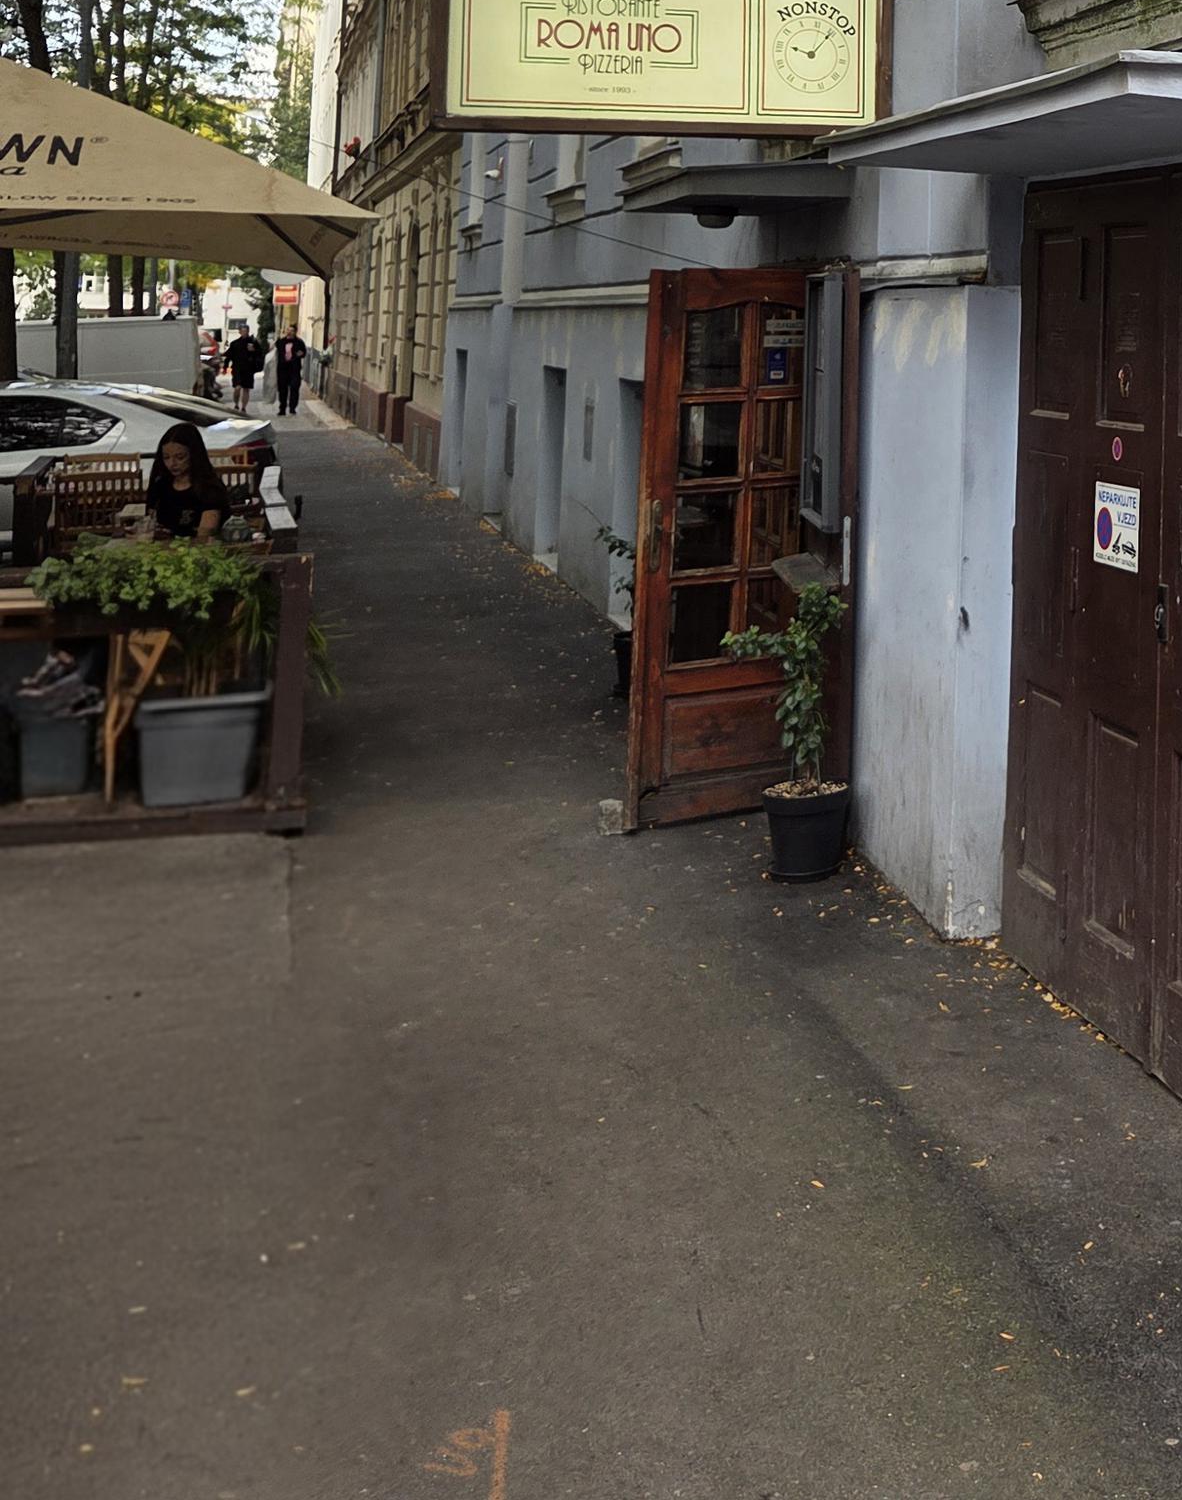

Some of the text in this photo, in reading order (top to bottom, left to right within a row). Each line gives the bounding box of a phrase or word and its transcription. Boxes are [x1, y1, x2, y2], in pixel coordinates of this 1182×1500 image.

[776, 0, 856, 37] NONSTOP
[537, 18, 682, 53] ROMA UNO
[578, 53, 643, 76] PIZZERIA
[1098, 490, 1137, 510] NEPARKUJTE
[1117, 511, 1137, 526] VJEZD
